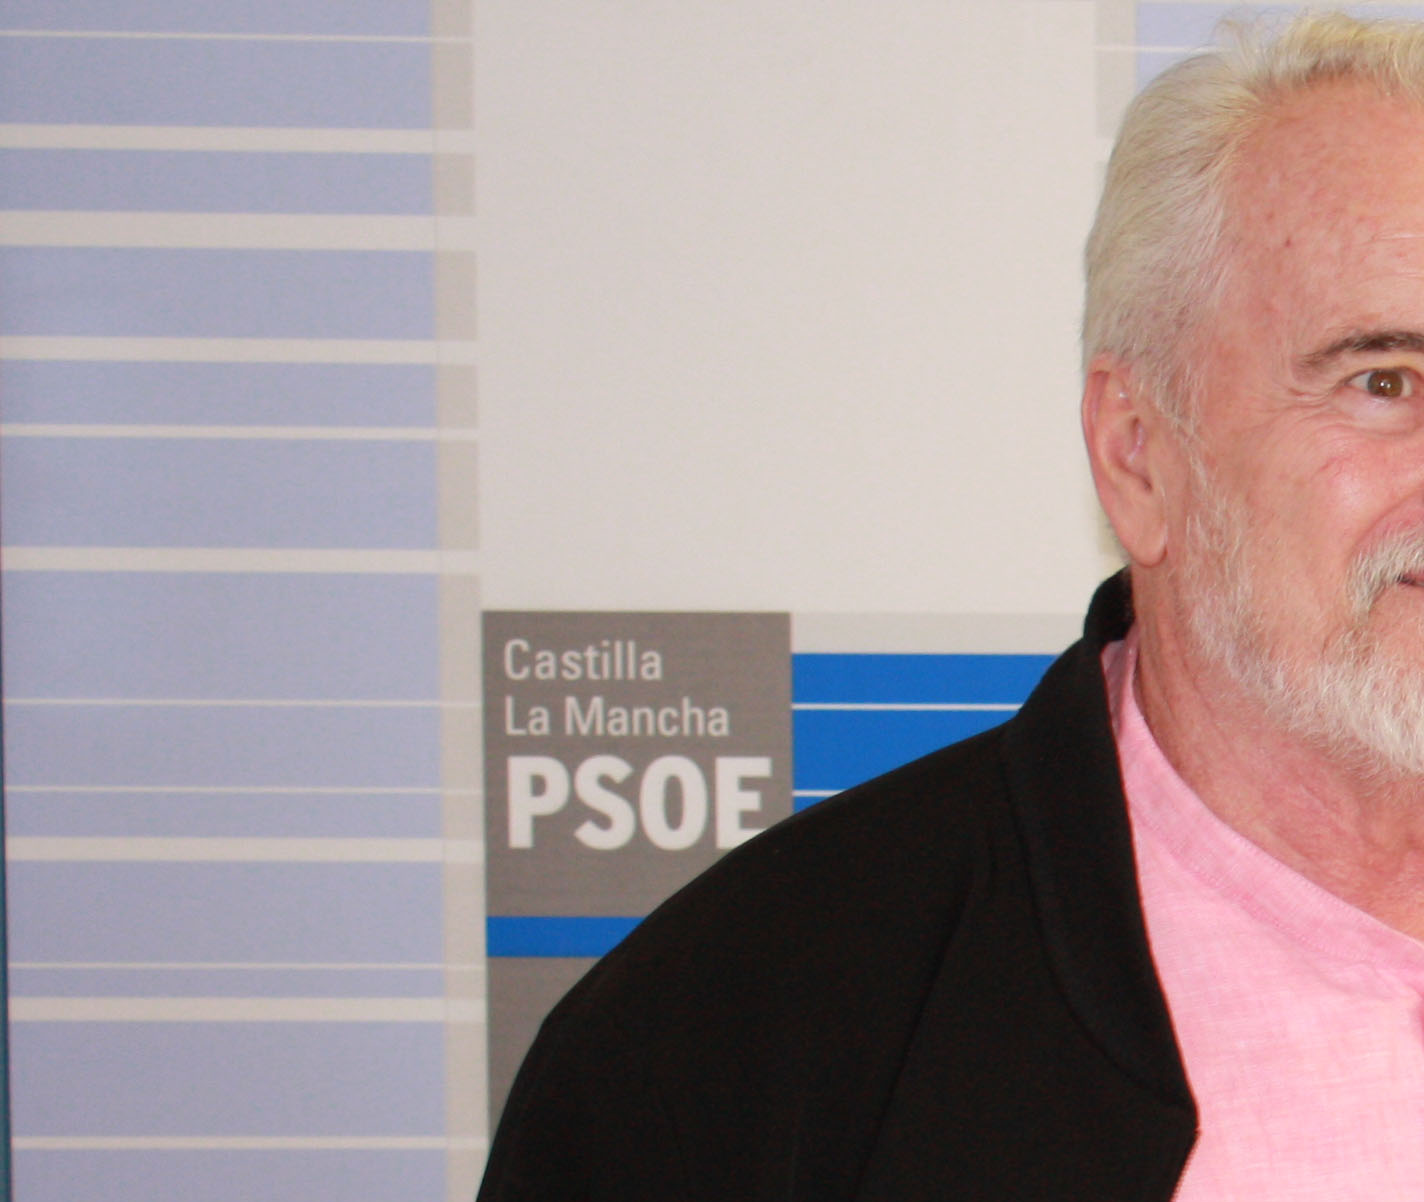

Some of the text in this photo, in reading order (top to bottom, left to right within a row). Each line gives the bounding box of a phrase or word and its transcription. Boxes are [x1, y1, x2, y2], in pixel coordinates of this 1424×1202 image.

[504, 638, 663, 681] Castilla
[505, 696, 730, 736] La Mancha
[507, 754, 773, 851] PSOE
